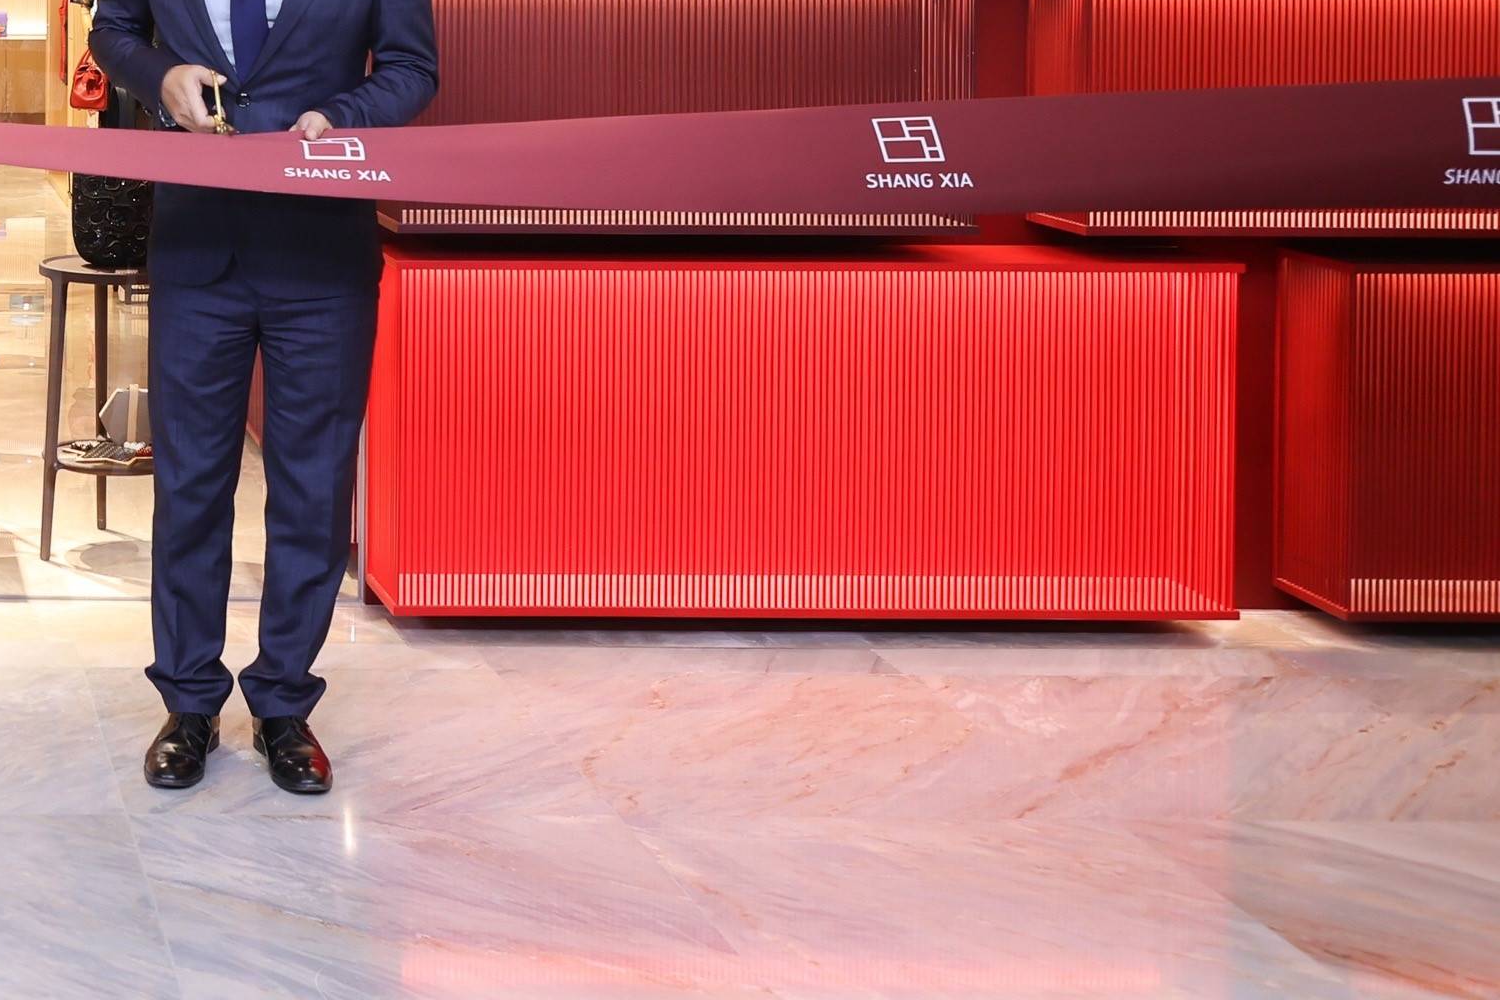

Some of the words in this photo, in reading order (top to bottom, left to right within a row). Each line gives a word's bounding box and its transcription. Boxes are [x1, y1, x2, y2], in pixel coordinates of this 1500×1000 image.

[283, 167, 351, 180] SHANG
[356, 170, 392, 182] XIA
[865, 173, 934, 189] SHANG
[938, 172, 974, 188] XIA
